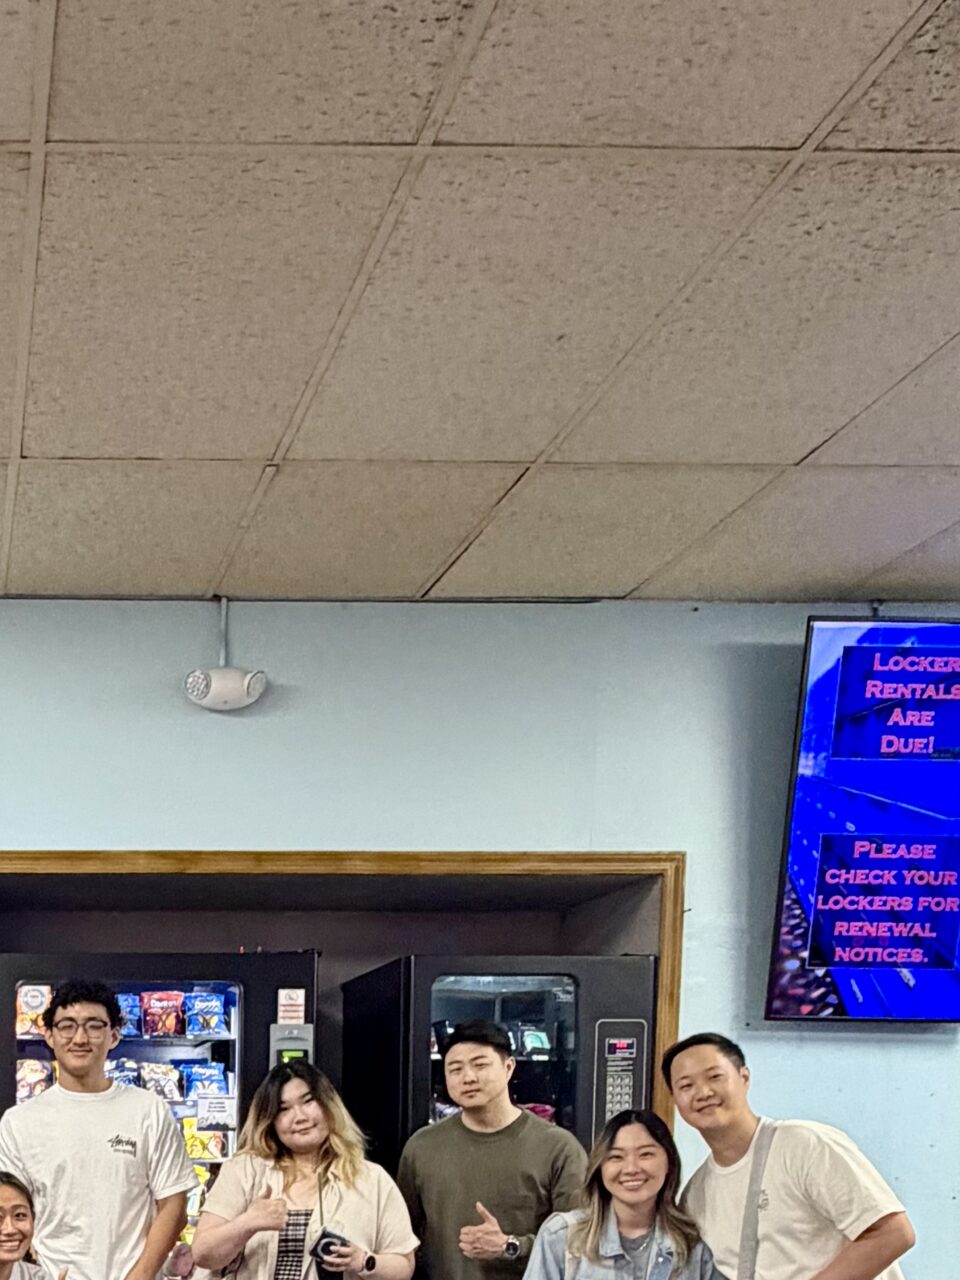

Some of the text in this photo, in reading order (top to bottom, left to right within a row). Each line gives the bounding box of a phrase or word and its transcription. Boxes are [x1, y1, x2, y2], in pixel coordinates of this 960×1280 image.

[887, 708, 935, 726] ARE
[880, 735, 935, 753] DUE!
[853, 841, 937, 859] PLEASE
[825, 869, 958, 885] CHECK YOUR
[817, 895, 959, 912] LOCKERS FOR
[834, 921, 937, 937] RENEWAL
[834, 947, 929, 963] NOTICES.
